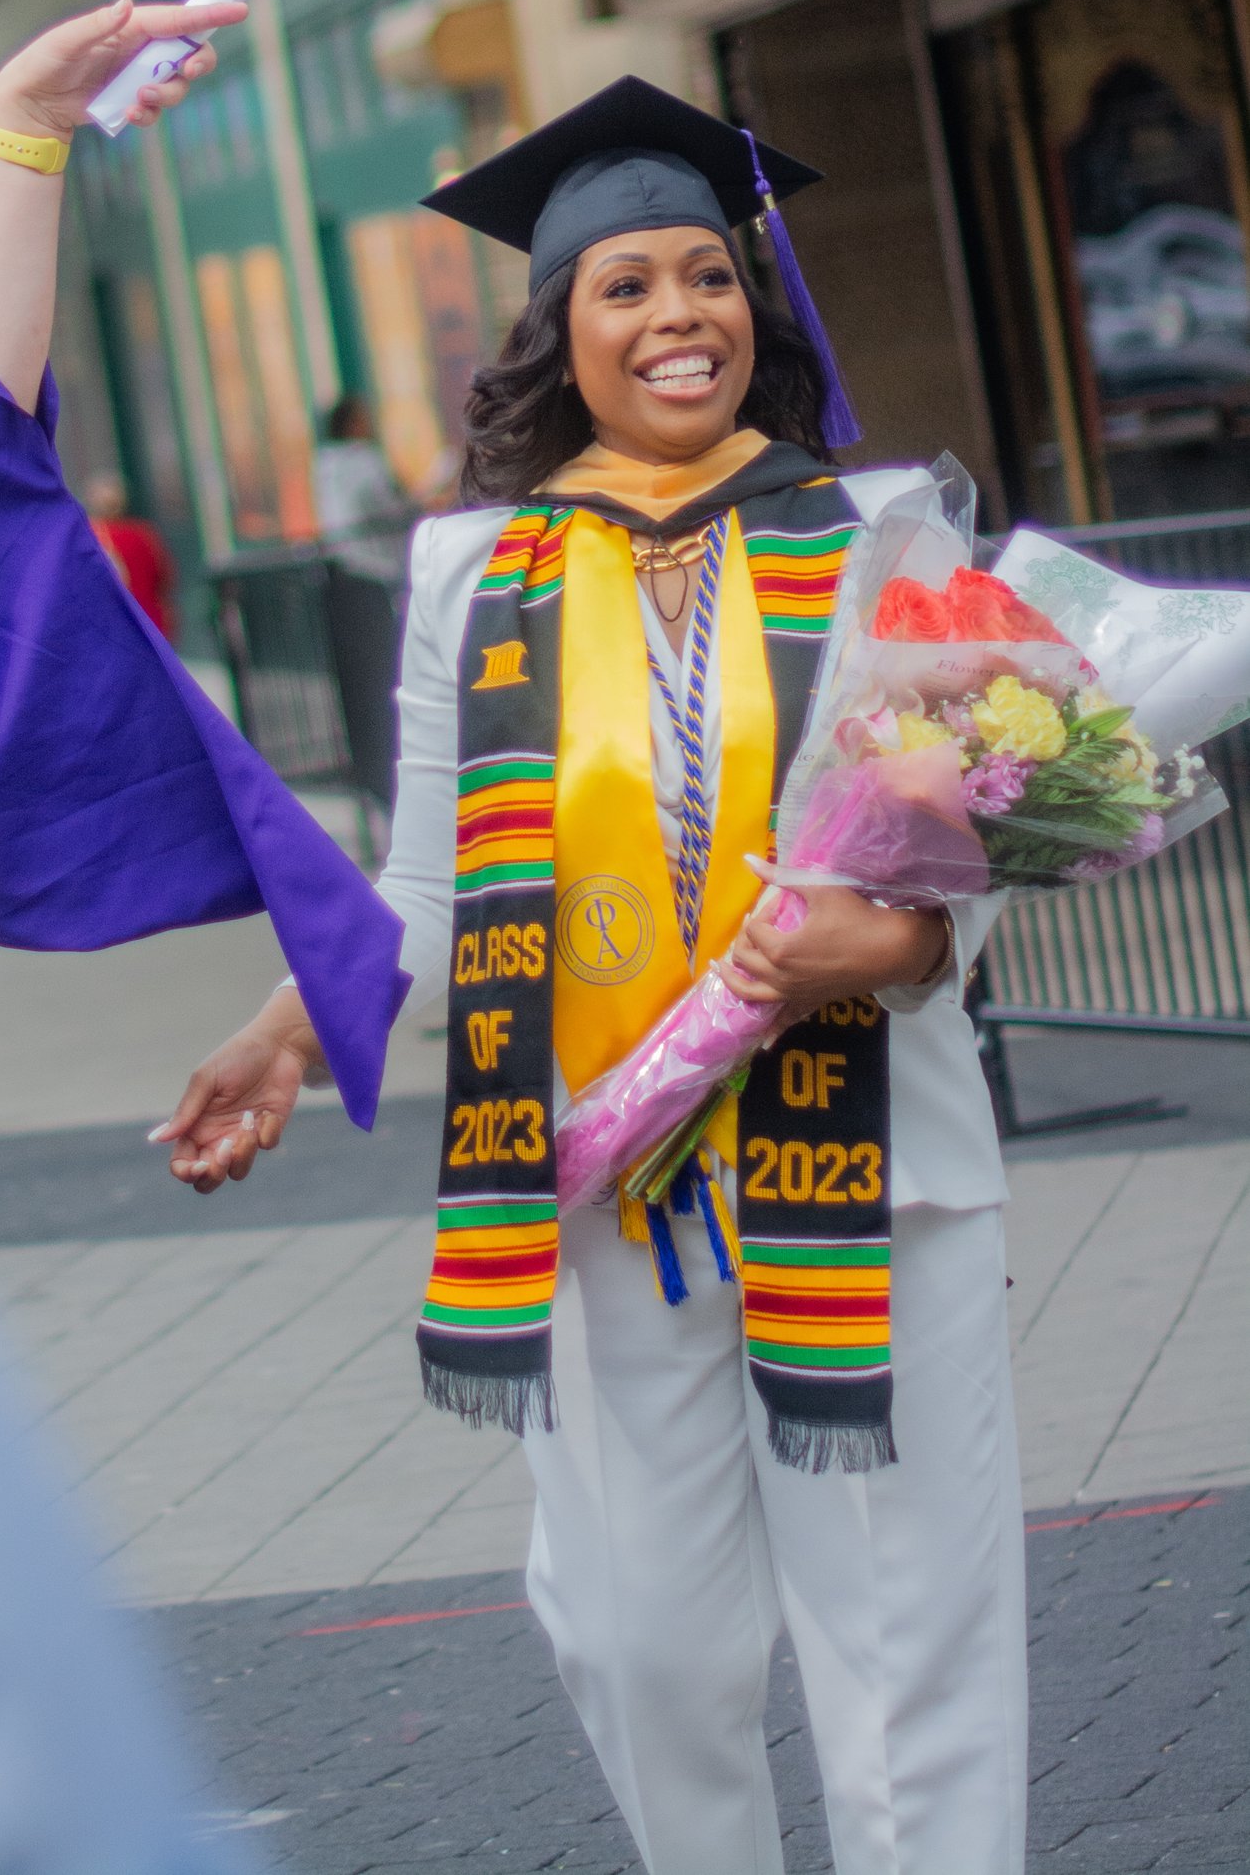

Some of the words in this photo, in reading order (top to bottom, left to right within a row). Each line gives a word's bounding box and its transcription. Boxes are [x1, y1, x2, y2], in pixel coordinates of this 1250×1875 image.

[569, 885, 587, 901] PHI
[590, 880, 621, 892] ALPHA
[454, 923, 546, 986] CLASS
[573, 962, 613, 982] HONOR
[614, 948, 648, 979] SOCIETY
[467, 1010, 513, 1071] OF
[781, 1048, 847, 1109] OF
[449, 1098, 547, 1166] 2023
[744, 1136, 883, 1204] 2023
